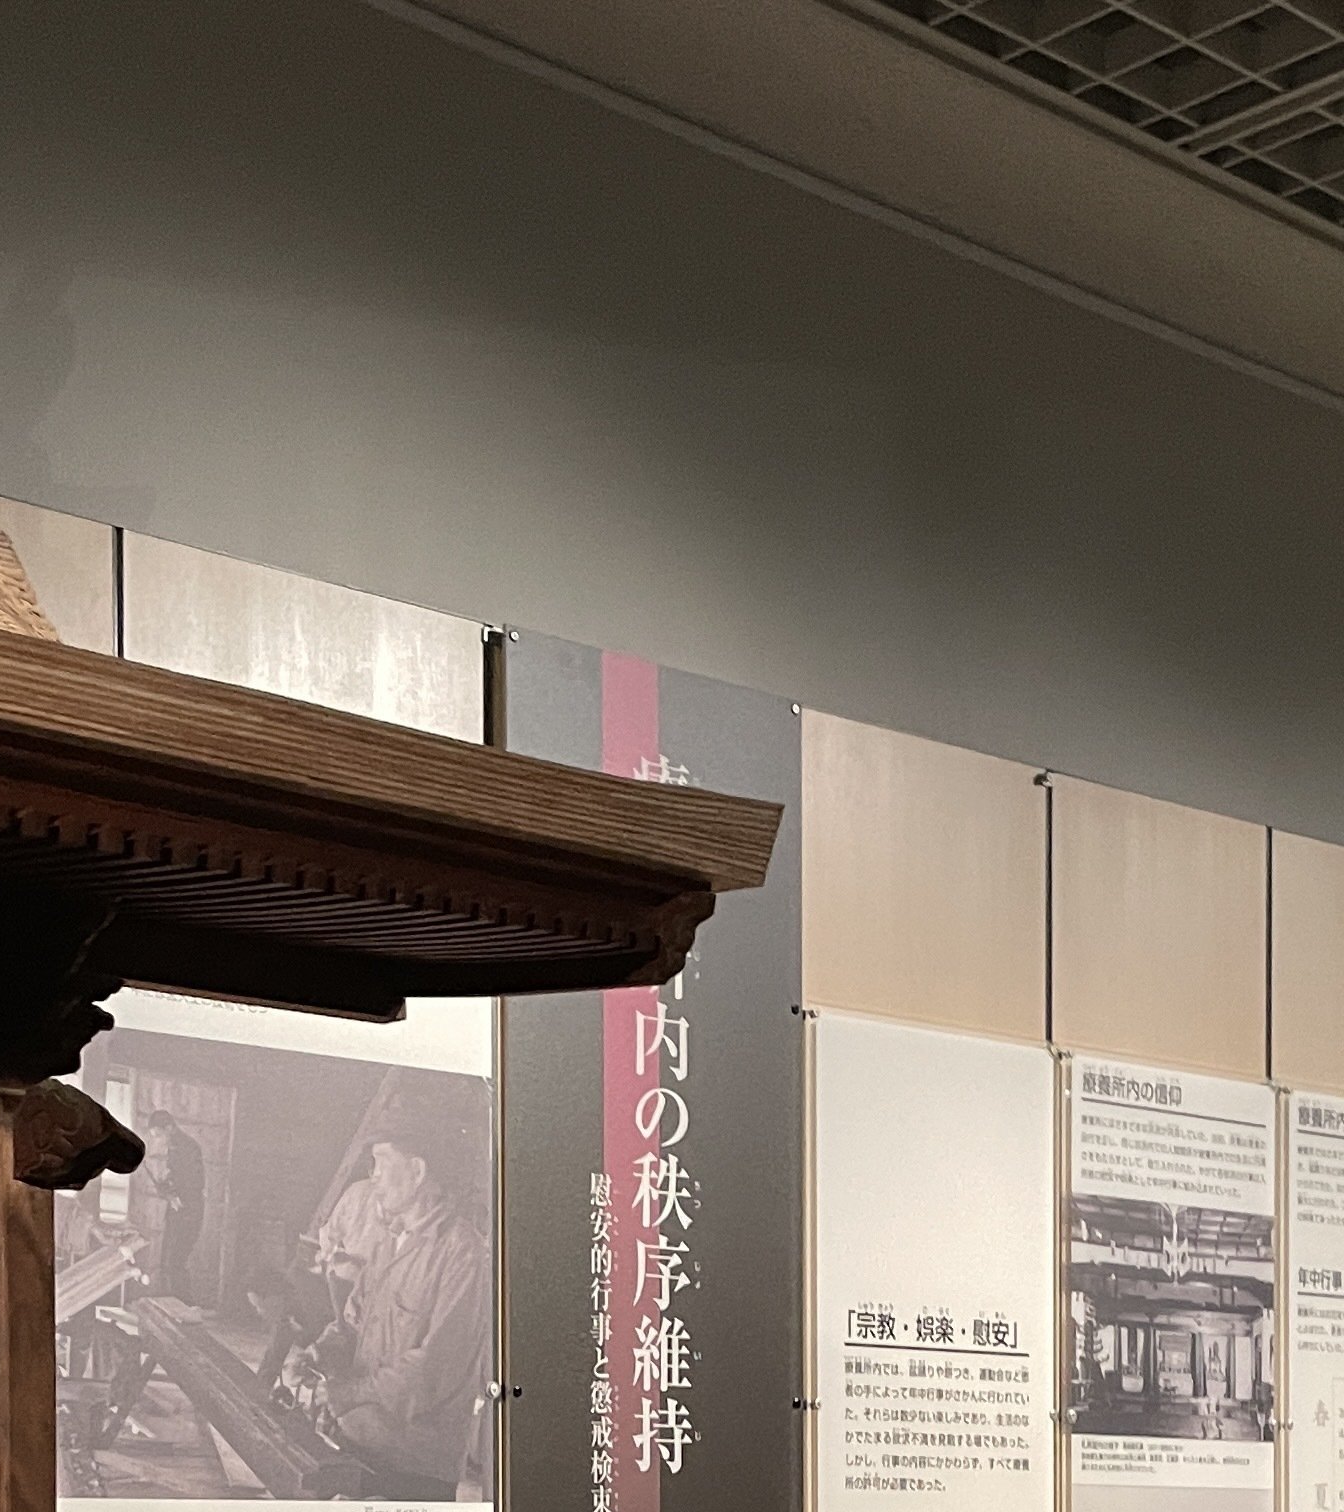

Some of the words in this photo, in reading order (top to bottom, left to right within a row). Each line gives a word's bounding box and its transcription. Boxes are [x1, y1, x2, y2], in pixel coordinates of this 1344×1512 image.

[849, 1309, 1018, 1348] 「宗教・娯楽・慰安」
